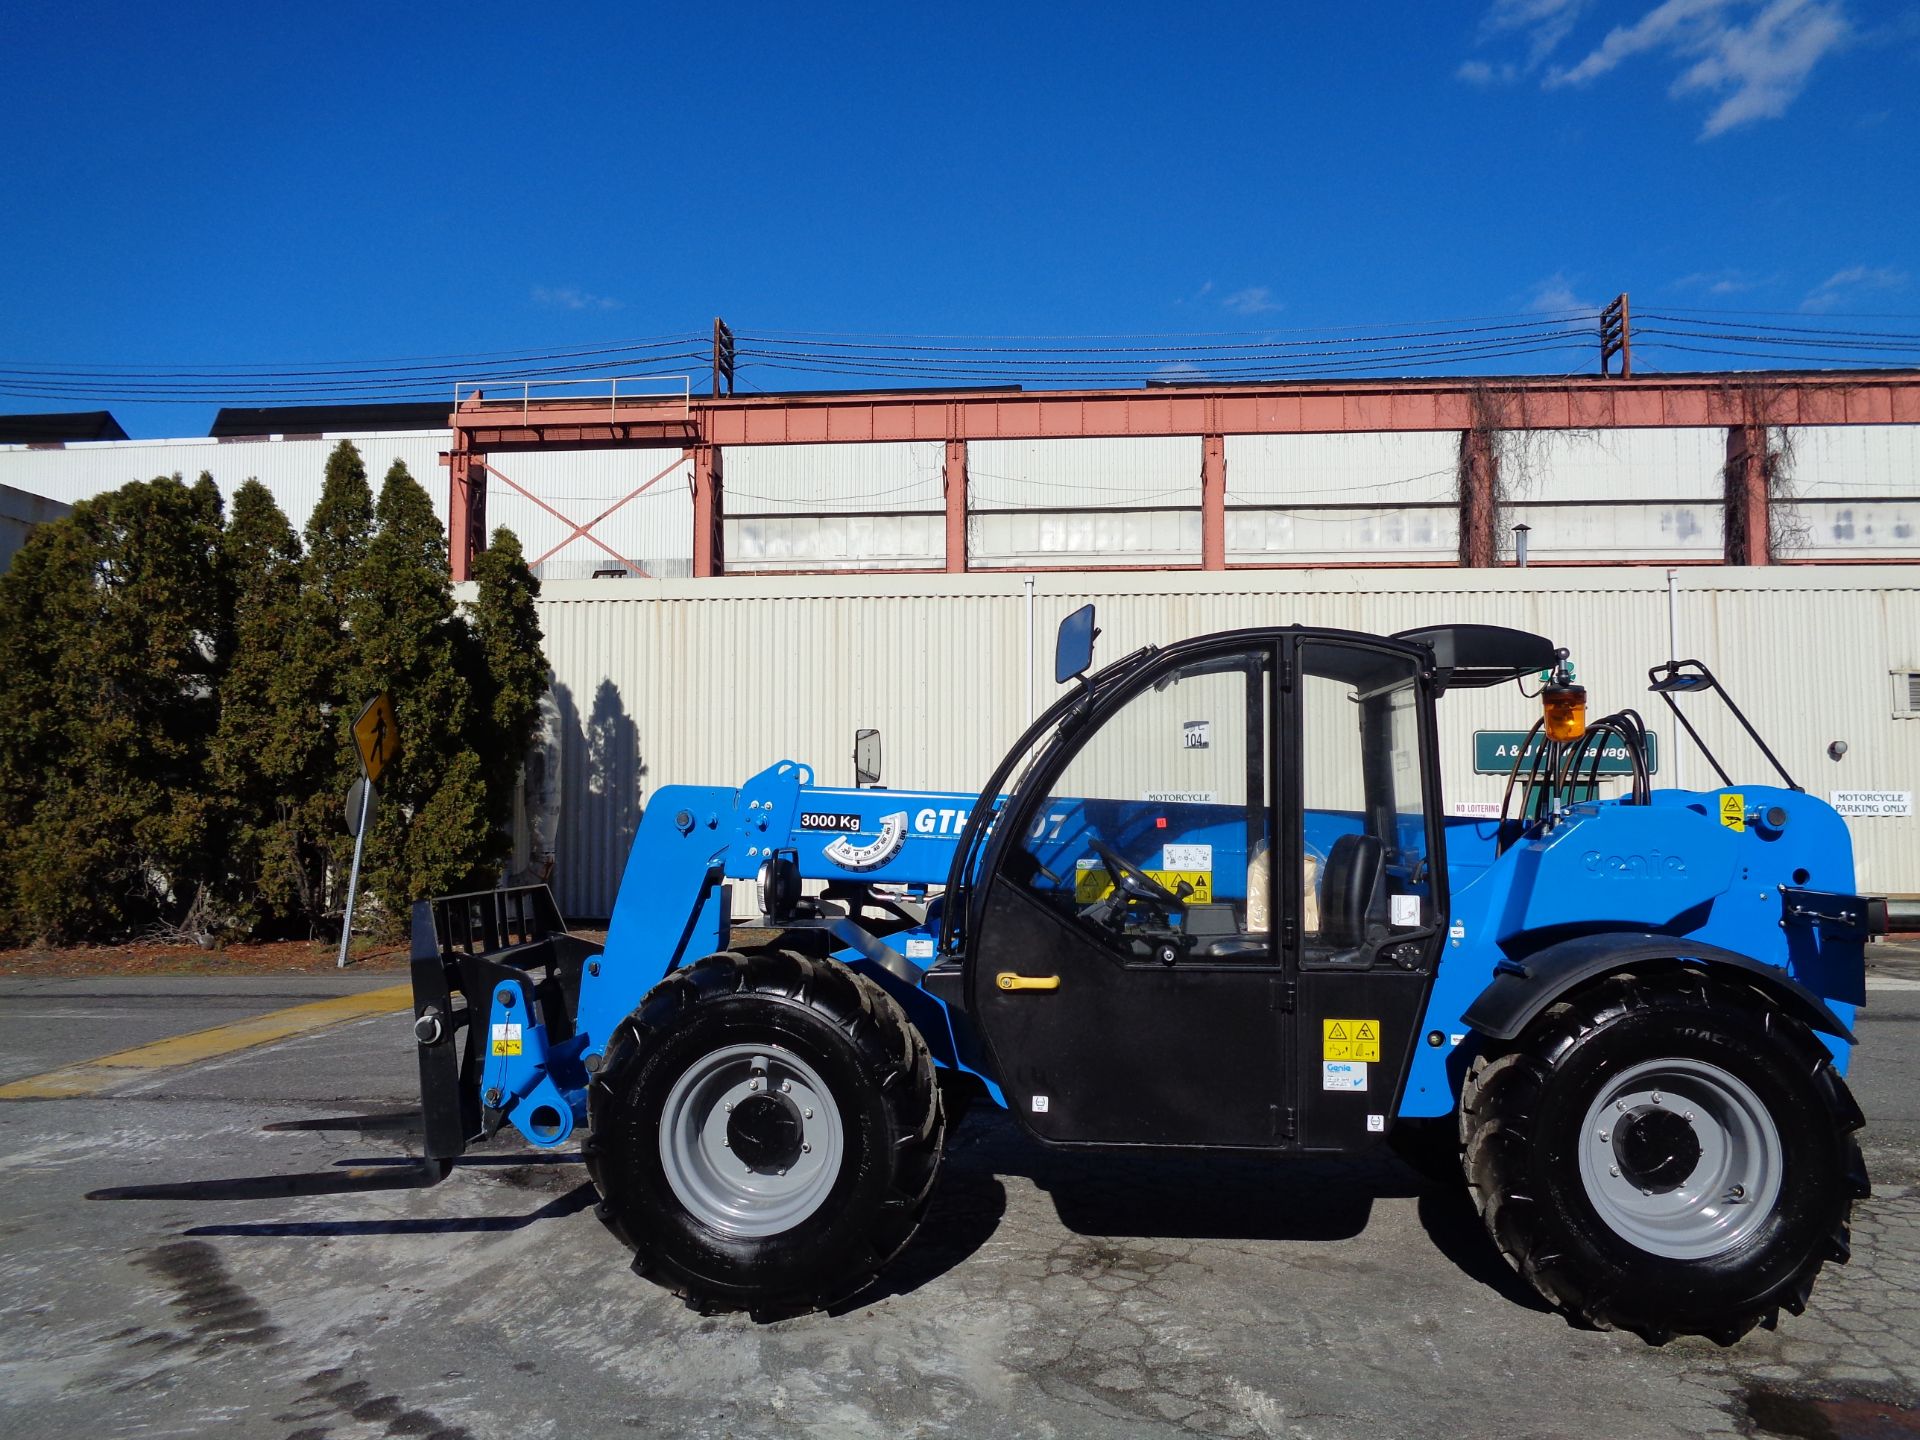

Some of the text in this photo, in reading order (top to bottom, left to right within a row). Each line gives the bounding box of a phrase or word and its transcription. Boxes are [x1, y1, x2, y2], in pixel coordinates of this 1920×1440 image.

[1185, 733, 1202, 747] 104
[1495, 745, 1506, 757] A
[1509, 745, 1520, 757] &
[1523, 745, 1532, 757] J
[1148, 793, 1210, 802] MOTORCYCLE
[1837, 793, 1904, 802] MOTORCYCLE
[1456, 804, 1500, 813] NO LOITERING
[1835, 804, 1908, 813] PARKING ONLY
[801, 814, 860, 831] 3000 Kg
[1580, 848, 1688, 880] Genie
[1327, 1063, 1351, 1072] Genie
